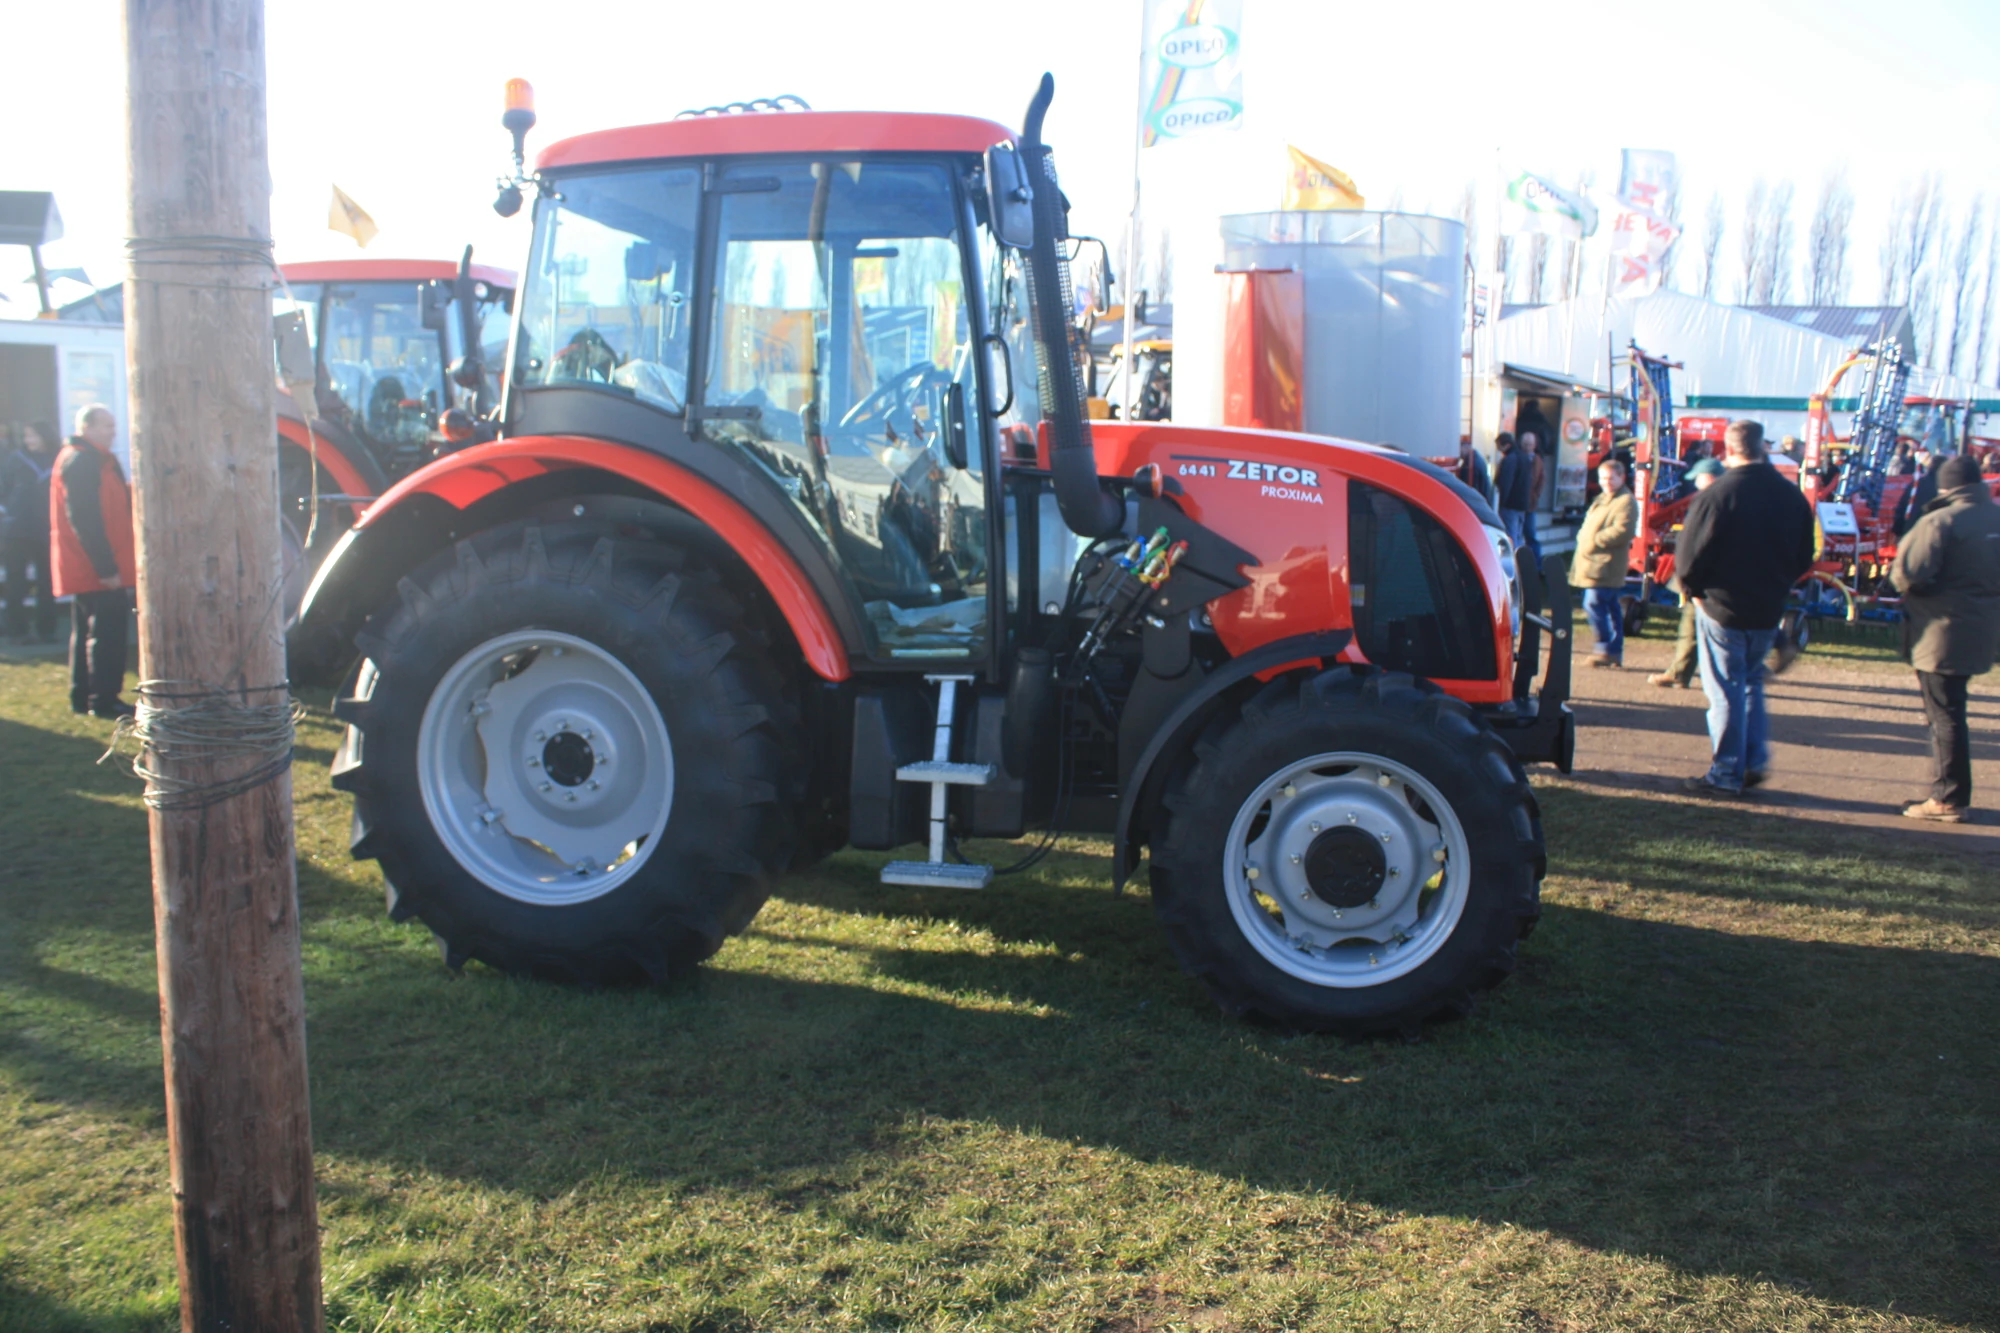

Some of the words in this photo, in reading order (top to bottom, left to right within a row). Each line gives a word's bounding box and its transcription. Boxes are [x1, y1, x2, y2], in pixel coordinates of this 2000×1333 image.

[1165, 109, 1229, 128] OPICO
[1178, 463, 1216, 477] 6441
[1226, 459, 1319, 488] ZETOR
[1261, 485, 1324, 504] PROXIMA
